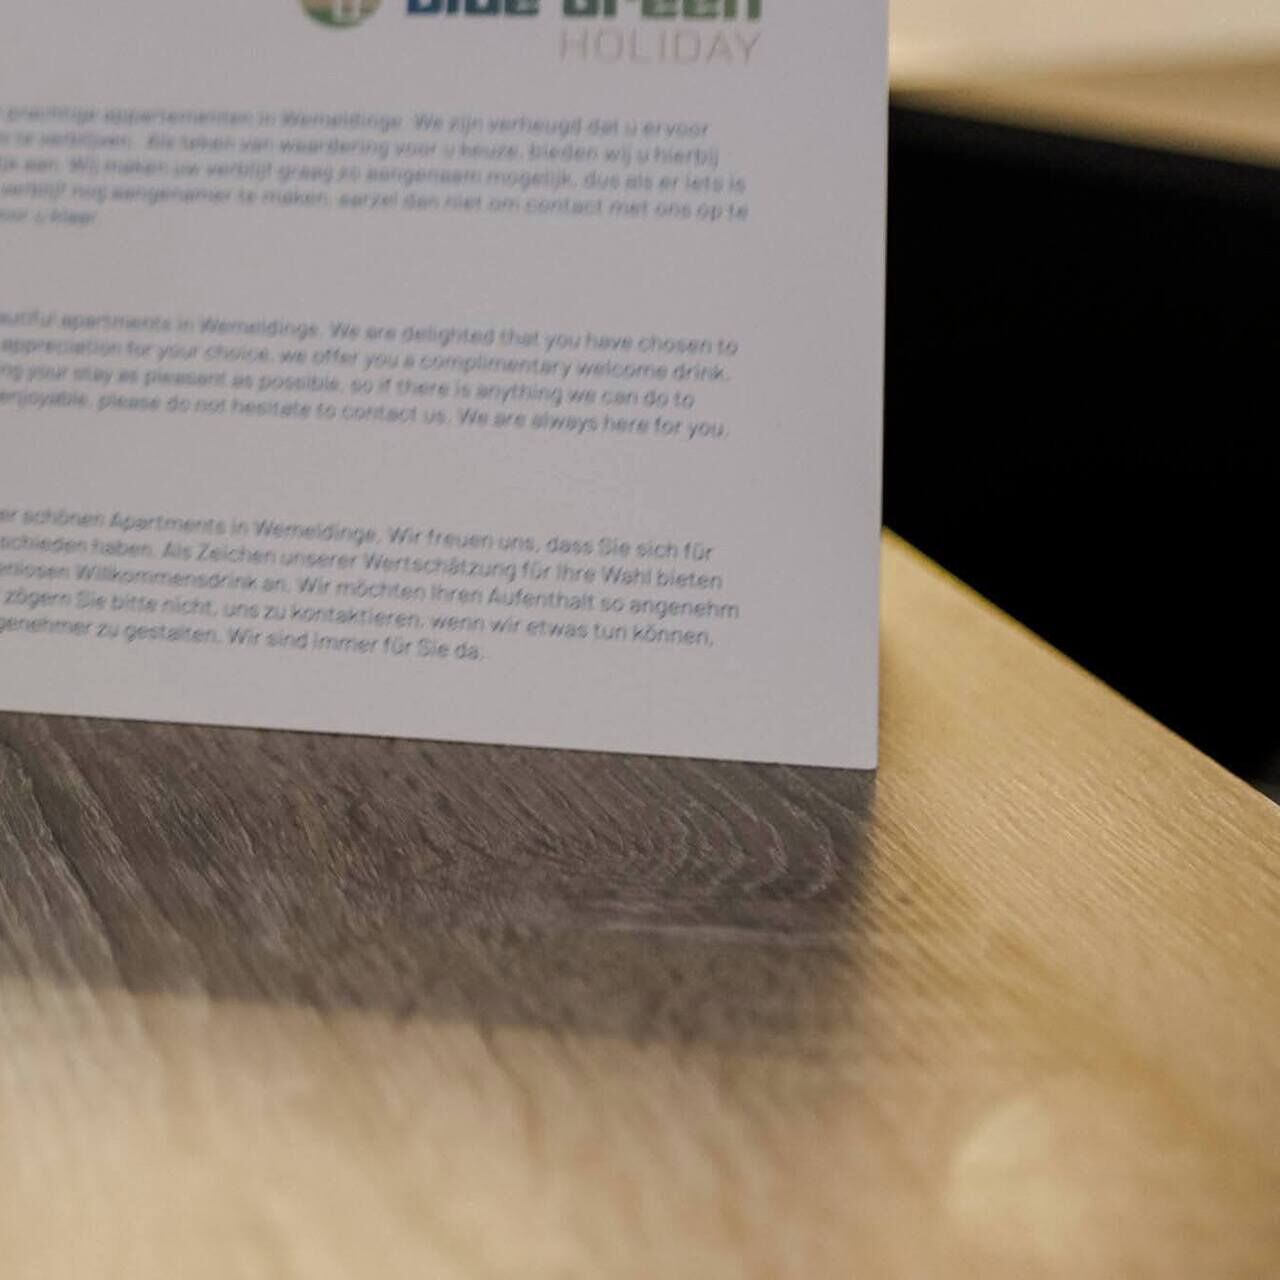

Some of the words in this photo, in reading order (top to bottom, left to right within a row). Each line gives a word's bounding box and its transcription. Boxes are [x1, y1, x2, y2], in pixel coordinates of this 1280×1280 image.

[558, 27, 762, 66] HOLIDAY
[109, 512, 226, 536] Apartments
[231, 518, 248, 534] in
[389, 526, 421, 543] Wir
[425, 528, 492, 547] freuen
[545, 534, 592, 552] dass
[597, 537, 630, 554] Sie
[636, 539, 678, 557] sich
[683, 541, 713, 559] für
[162, 541, 191, 558] Als
[196, 543, 276, 563] Zeichen
[280, 550, 356, 567] unserer
[521, 560, 550, 577] für
[556, 562, 594, 580] Ihre
[601, 565, 651, 583] Wahl
[656, 568, 722, 587] bieten
[76, 563, 256, 589] Willkommensdrink
[298, 576, 331, 593] Wir
[431, 583, 482, 601] Ihren
[487, 586, 592, 607] Aufenthalt
[600, 595, 624, 609] so
[630, 594, 739, 618] angenehm
[76, 591, 105, 608] Sie
[110, 593, 156, 611] bitte
[222, 602, 259, 617] uns
[263, 604, 285, 619] zu
[432, 614, 485, 630] wenn
[491, 615, 519, 632] wir
[526, 617, 588, 636] etwas
[593, 621, 626, 638] tun
[96, 622, 119, 637] zu
[228, 628, 262, 645] Wir
[267, 630, 307, 648] sind
[314, 633, 378, 652] immer
[382, 637, 410, 654] für
[417, 639, 449, 656] Sie
